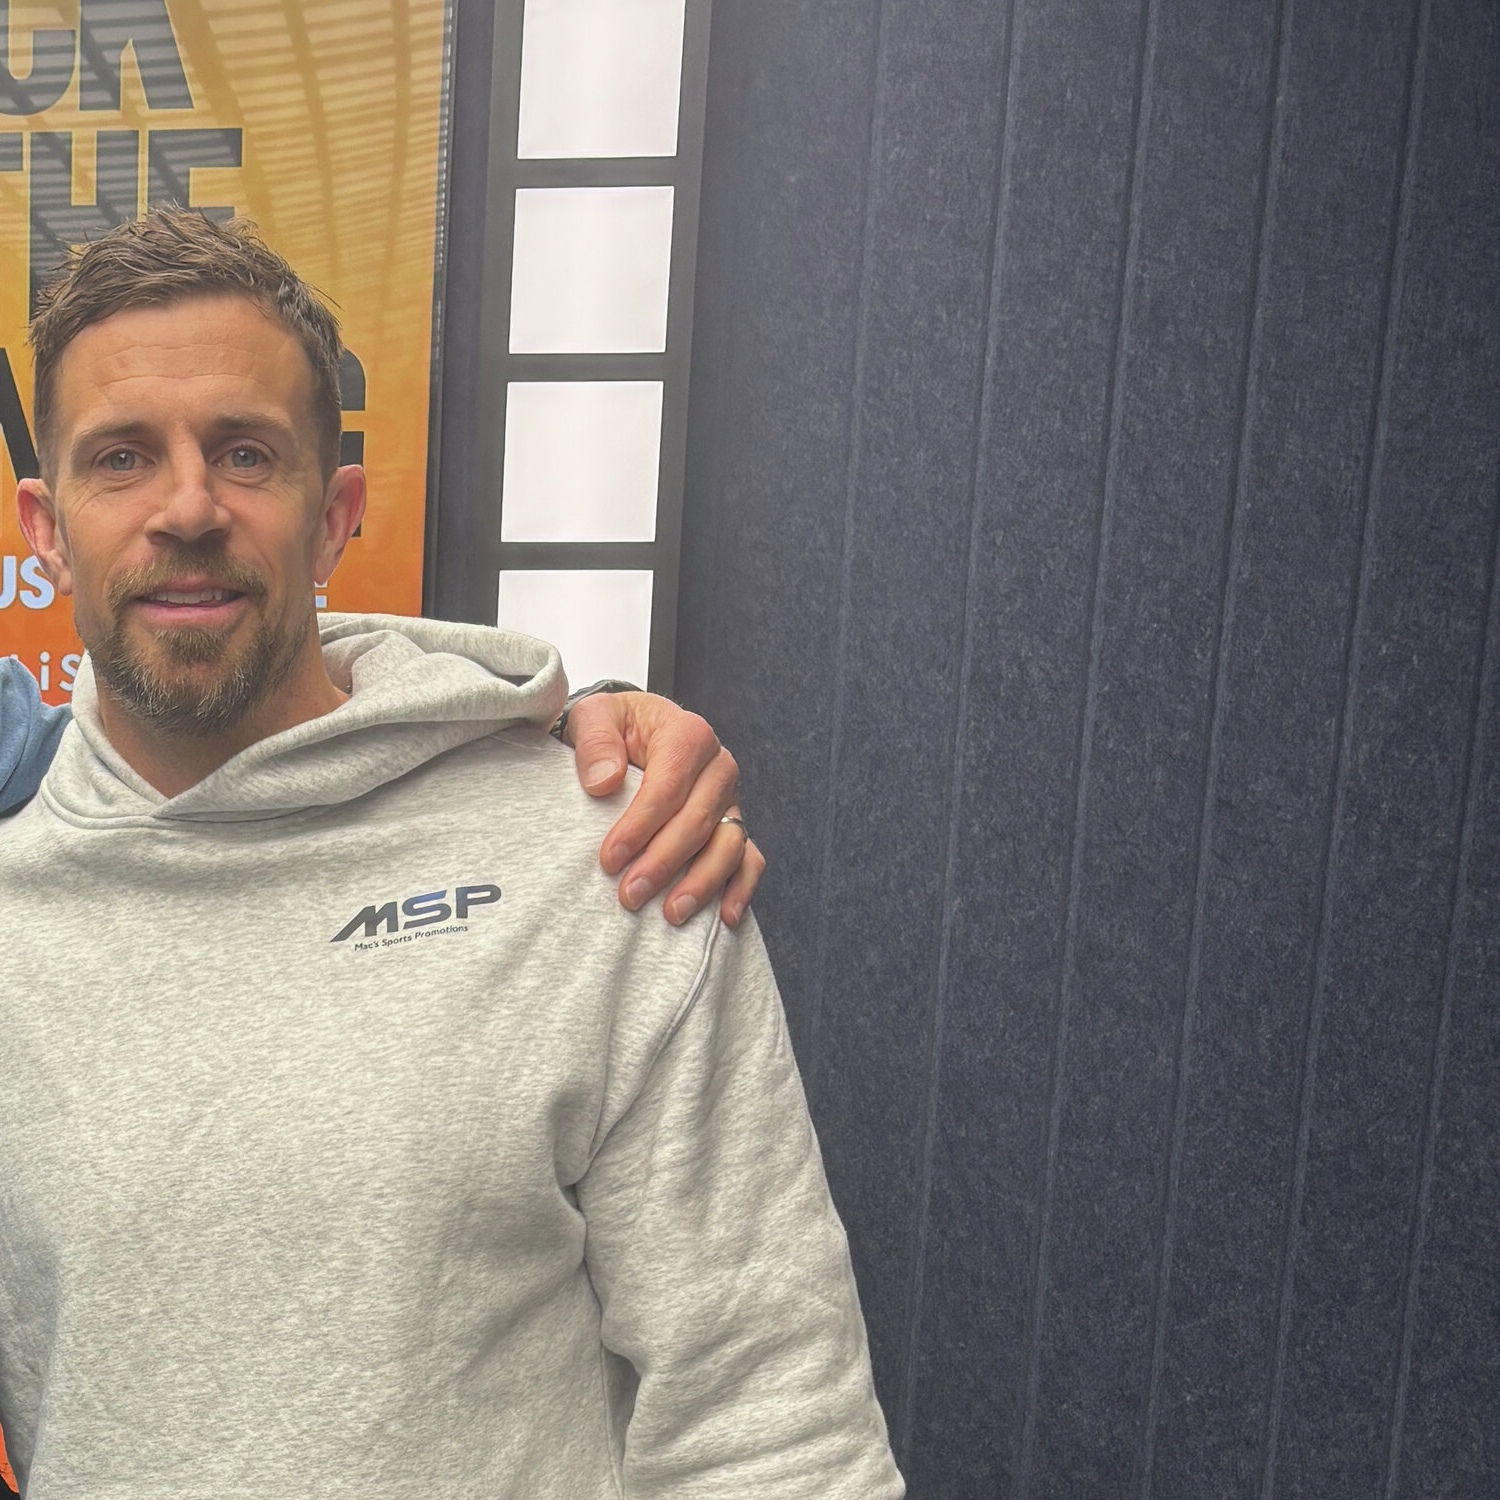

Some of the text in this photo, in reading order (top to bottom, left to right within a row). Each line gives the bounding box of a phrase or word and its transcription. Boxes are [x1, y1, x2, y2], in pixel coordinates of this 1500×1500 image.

[329, 884, 502, 943] MSP
[354, 925, 469, 952] Mac's Sports Promotions
